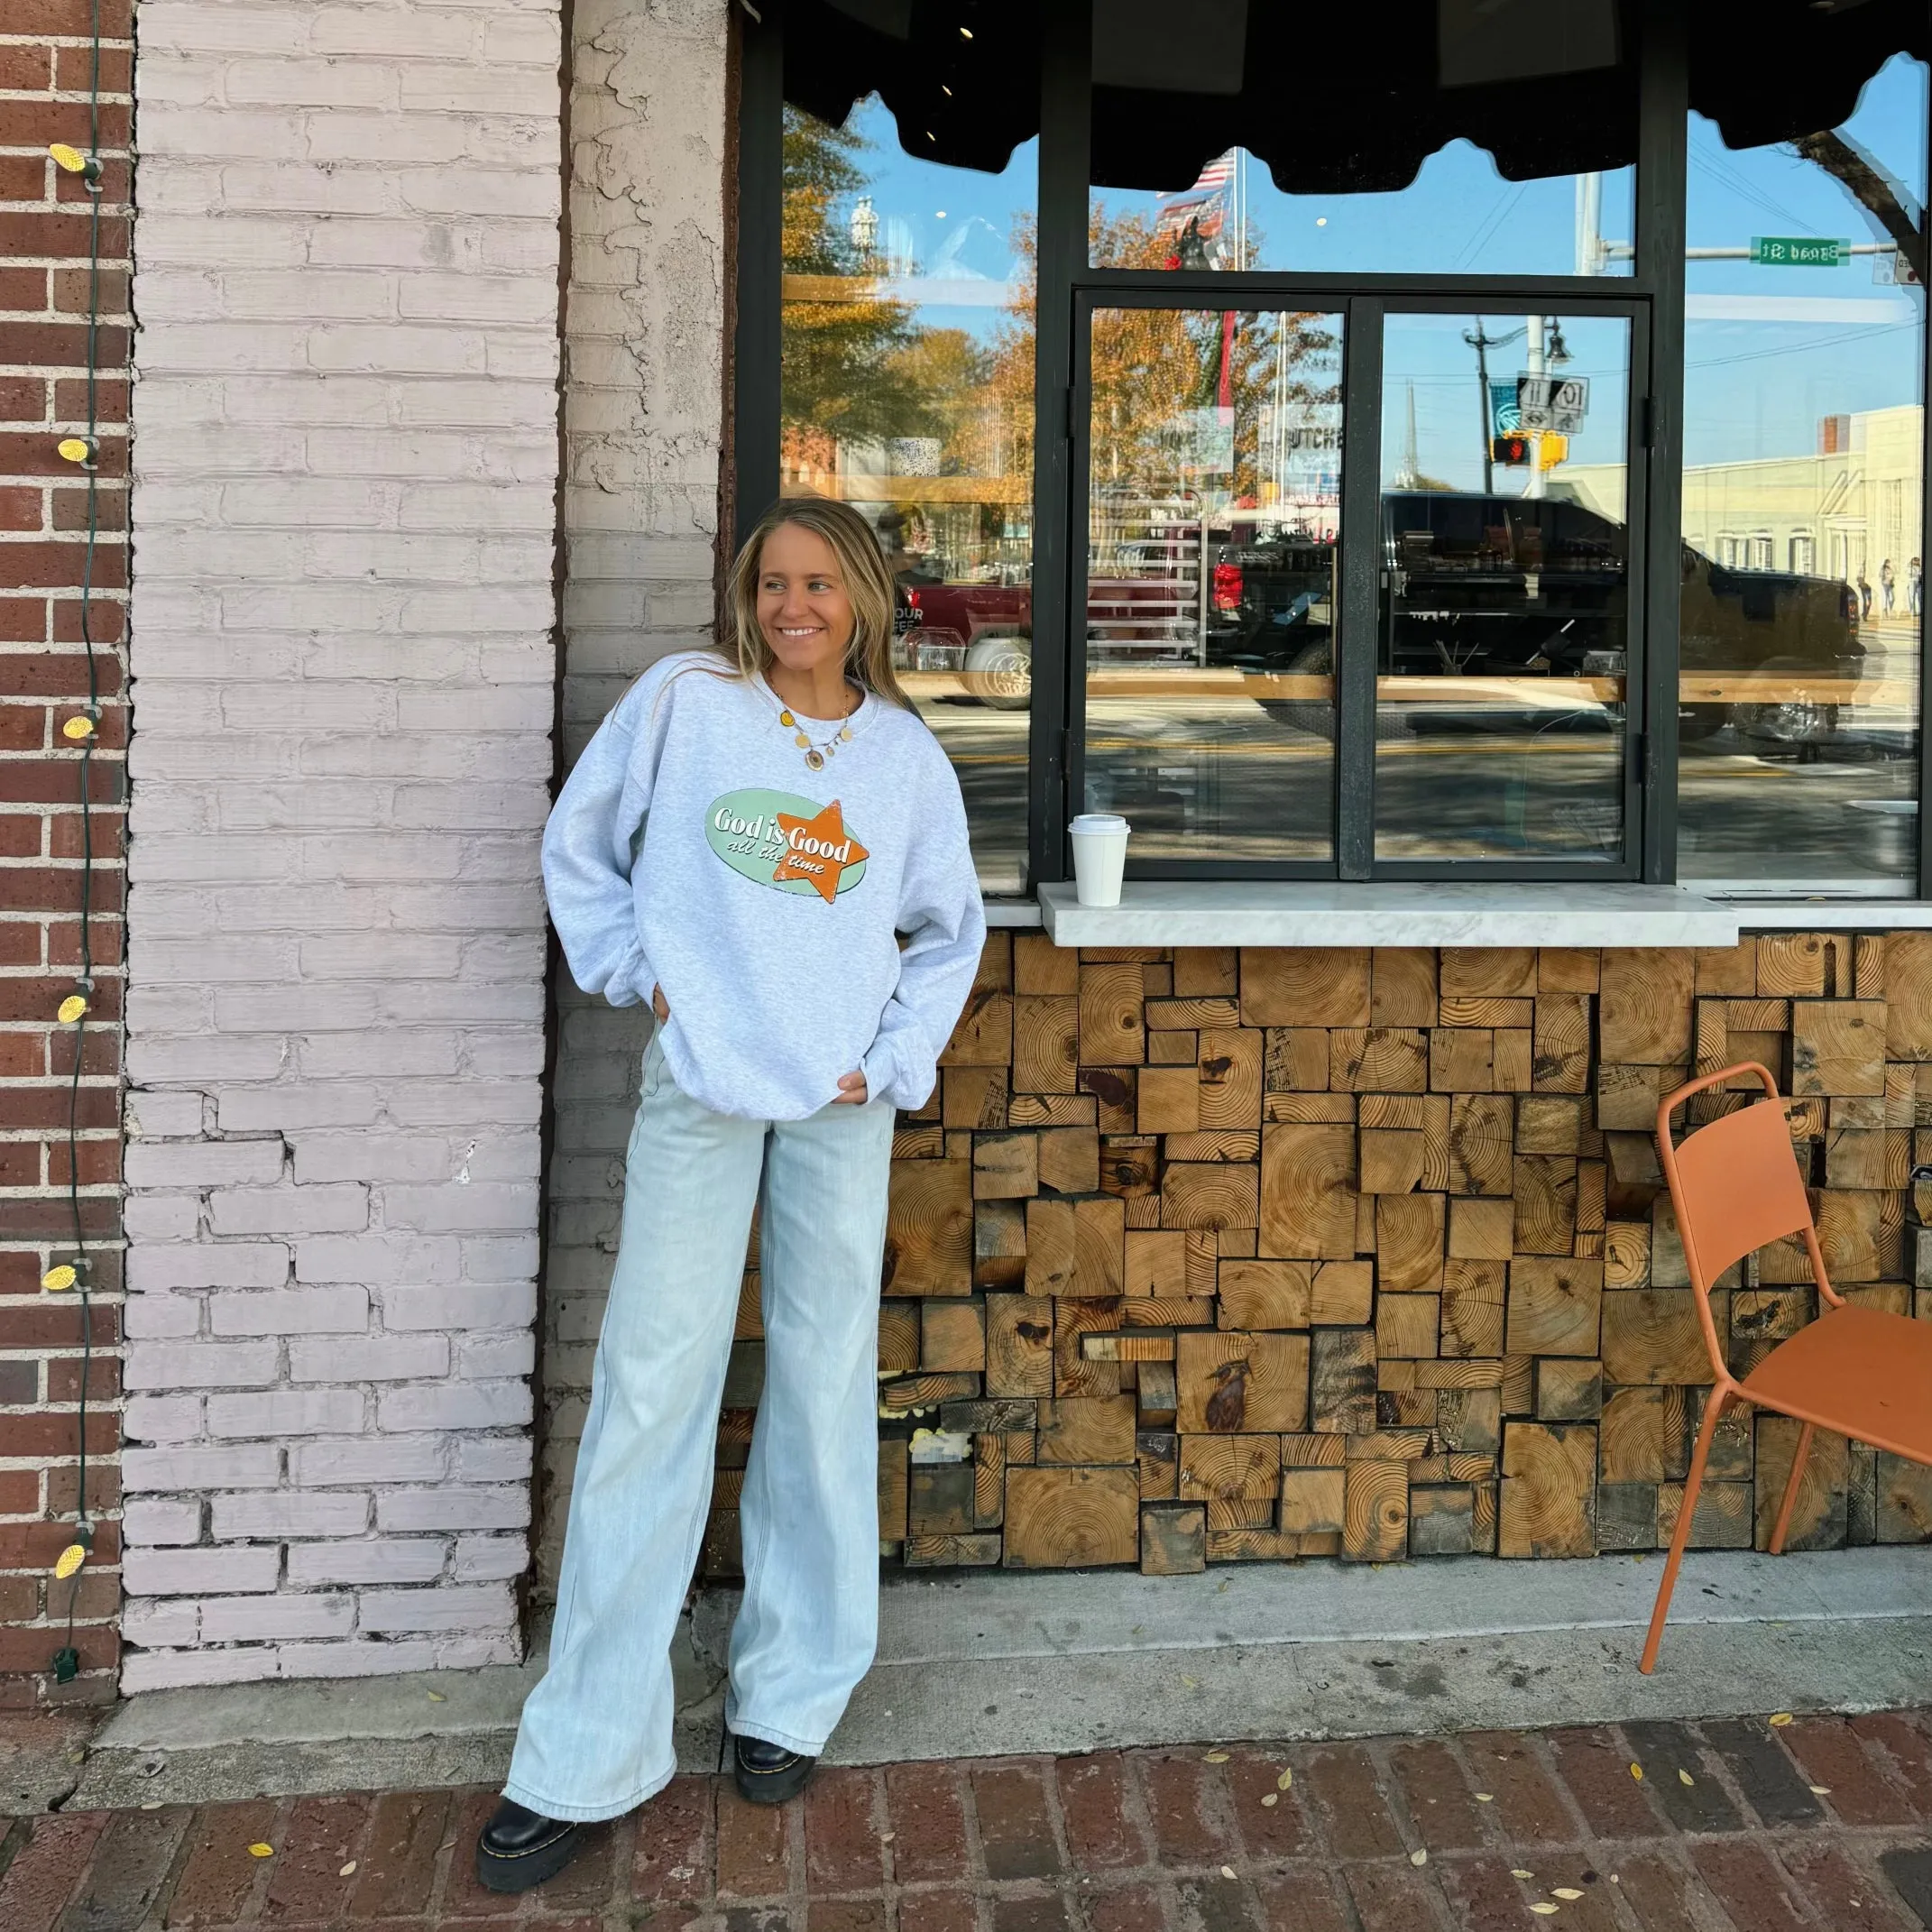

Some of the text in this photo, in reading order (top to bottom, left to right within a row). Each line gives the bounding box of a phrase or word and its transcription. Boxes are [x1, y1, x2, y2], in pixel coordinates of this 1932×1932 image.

[714, 807, 851, 864] God is Good
[727, 840, 825, 874] all the time
